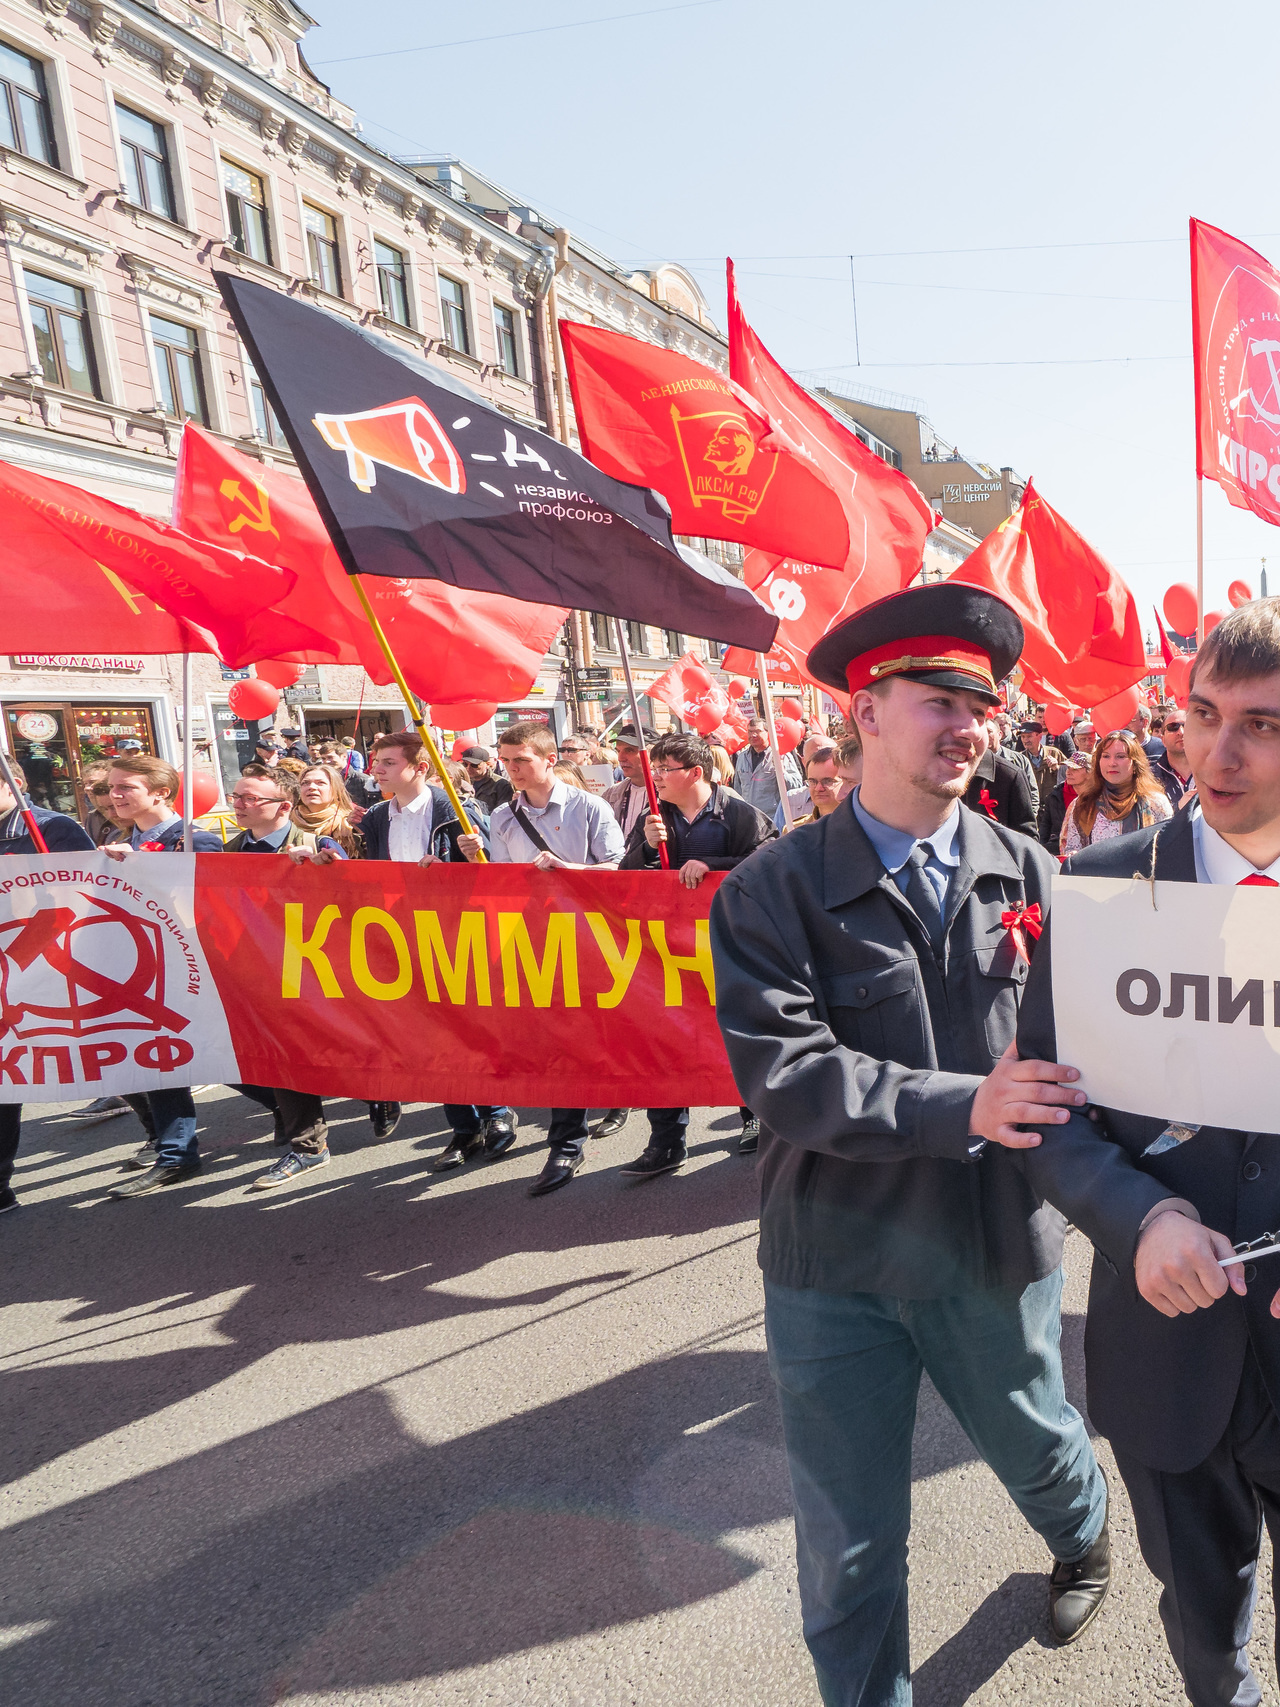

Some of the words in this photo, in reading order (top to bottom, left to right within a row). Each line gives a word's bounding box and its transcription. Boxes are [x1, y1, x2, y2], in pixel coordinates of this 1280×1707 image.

[1224, 318, 1248, 351] ТРУД
[640, 378, 718, 402] ЛЕНИНСКИЙ
[696, 475, 735, 495] ЛКСМ
[737, 484, 758, 503] РФ
[963, 481, 1002, 492] НЕВСКИЙ
[963, 493, 990, 504] ЦЕНТР
[518, 501, 613, 525] профсоюз
[18, 655, 146, 671] ШОКОЛАДНИЦА
[30, 719, 45, 729] 24
[146, 899, 201, 996] СОЦИАЛИЗМ
[281, 902, 716, 1009] КОММУН
[0, 1034, 195, 1086] КПРФ
